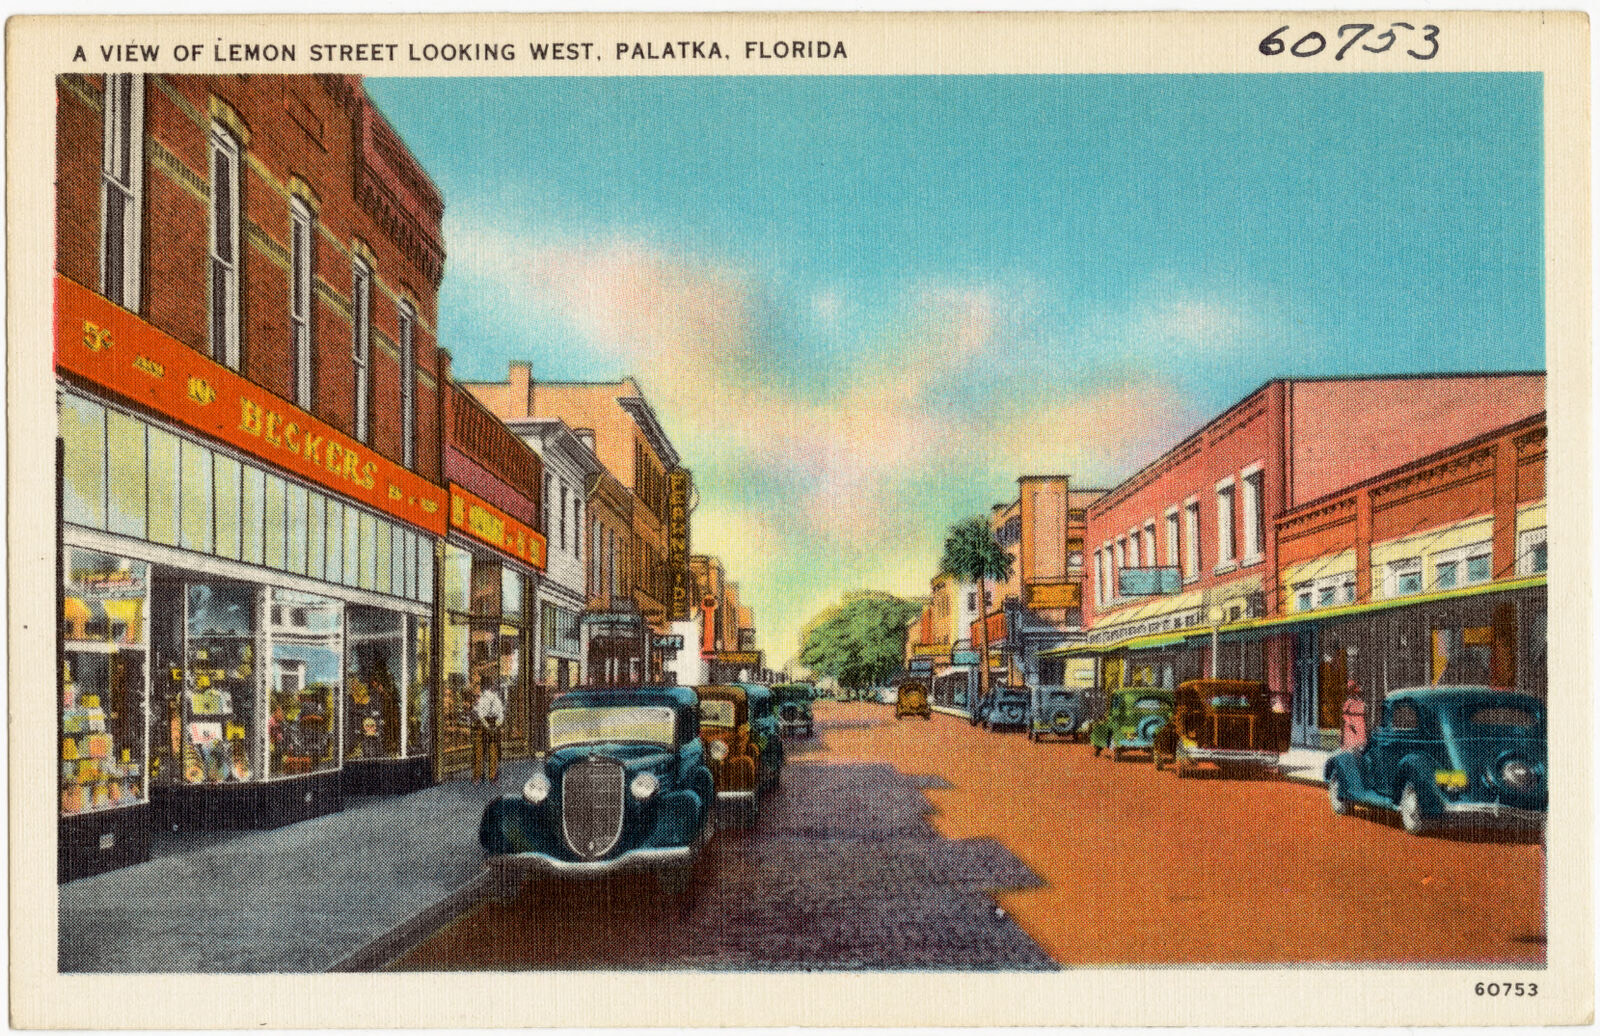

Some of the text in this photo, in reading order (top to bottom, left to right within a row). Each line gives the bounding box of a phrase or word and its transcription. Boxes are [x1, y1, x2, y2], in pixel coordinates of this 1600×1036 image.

[1258, 22, 1440, 61] 60753
[238, 396, 378, 490] BECKERS
[652, 636, 682, 648] CAFE
